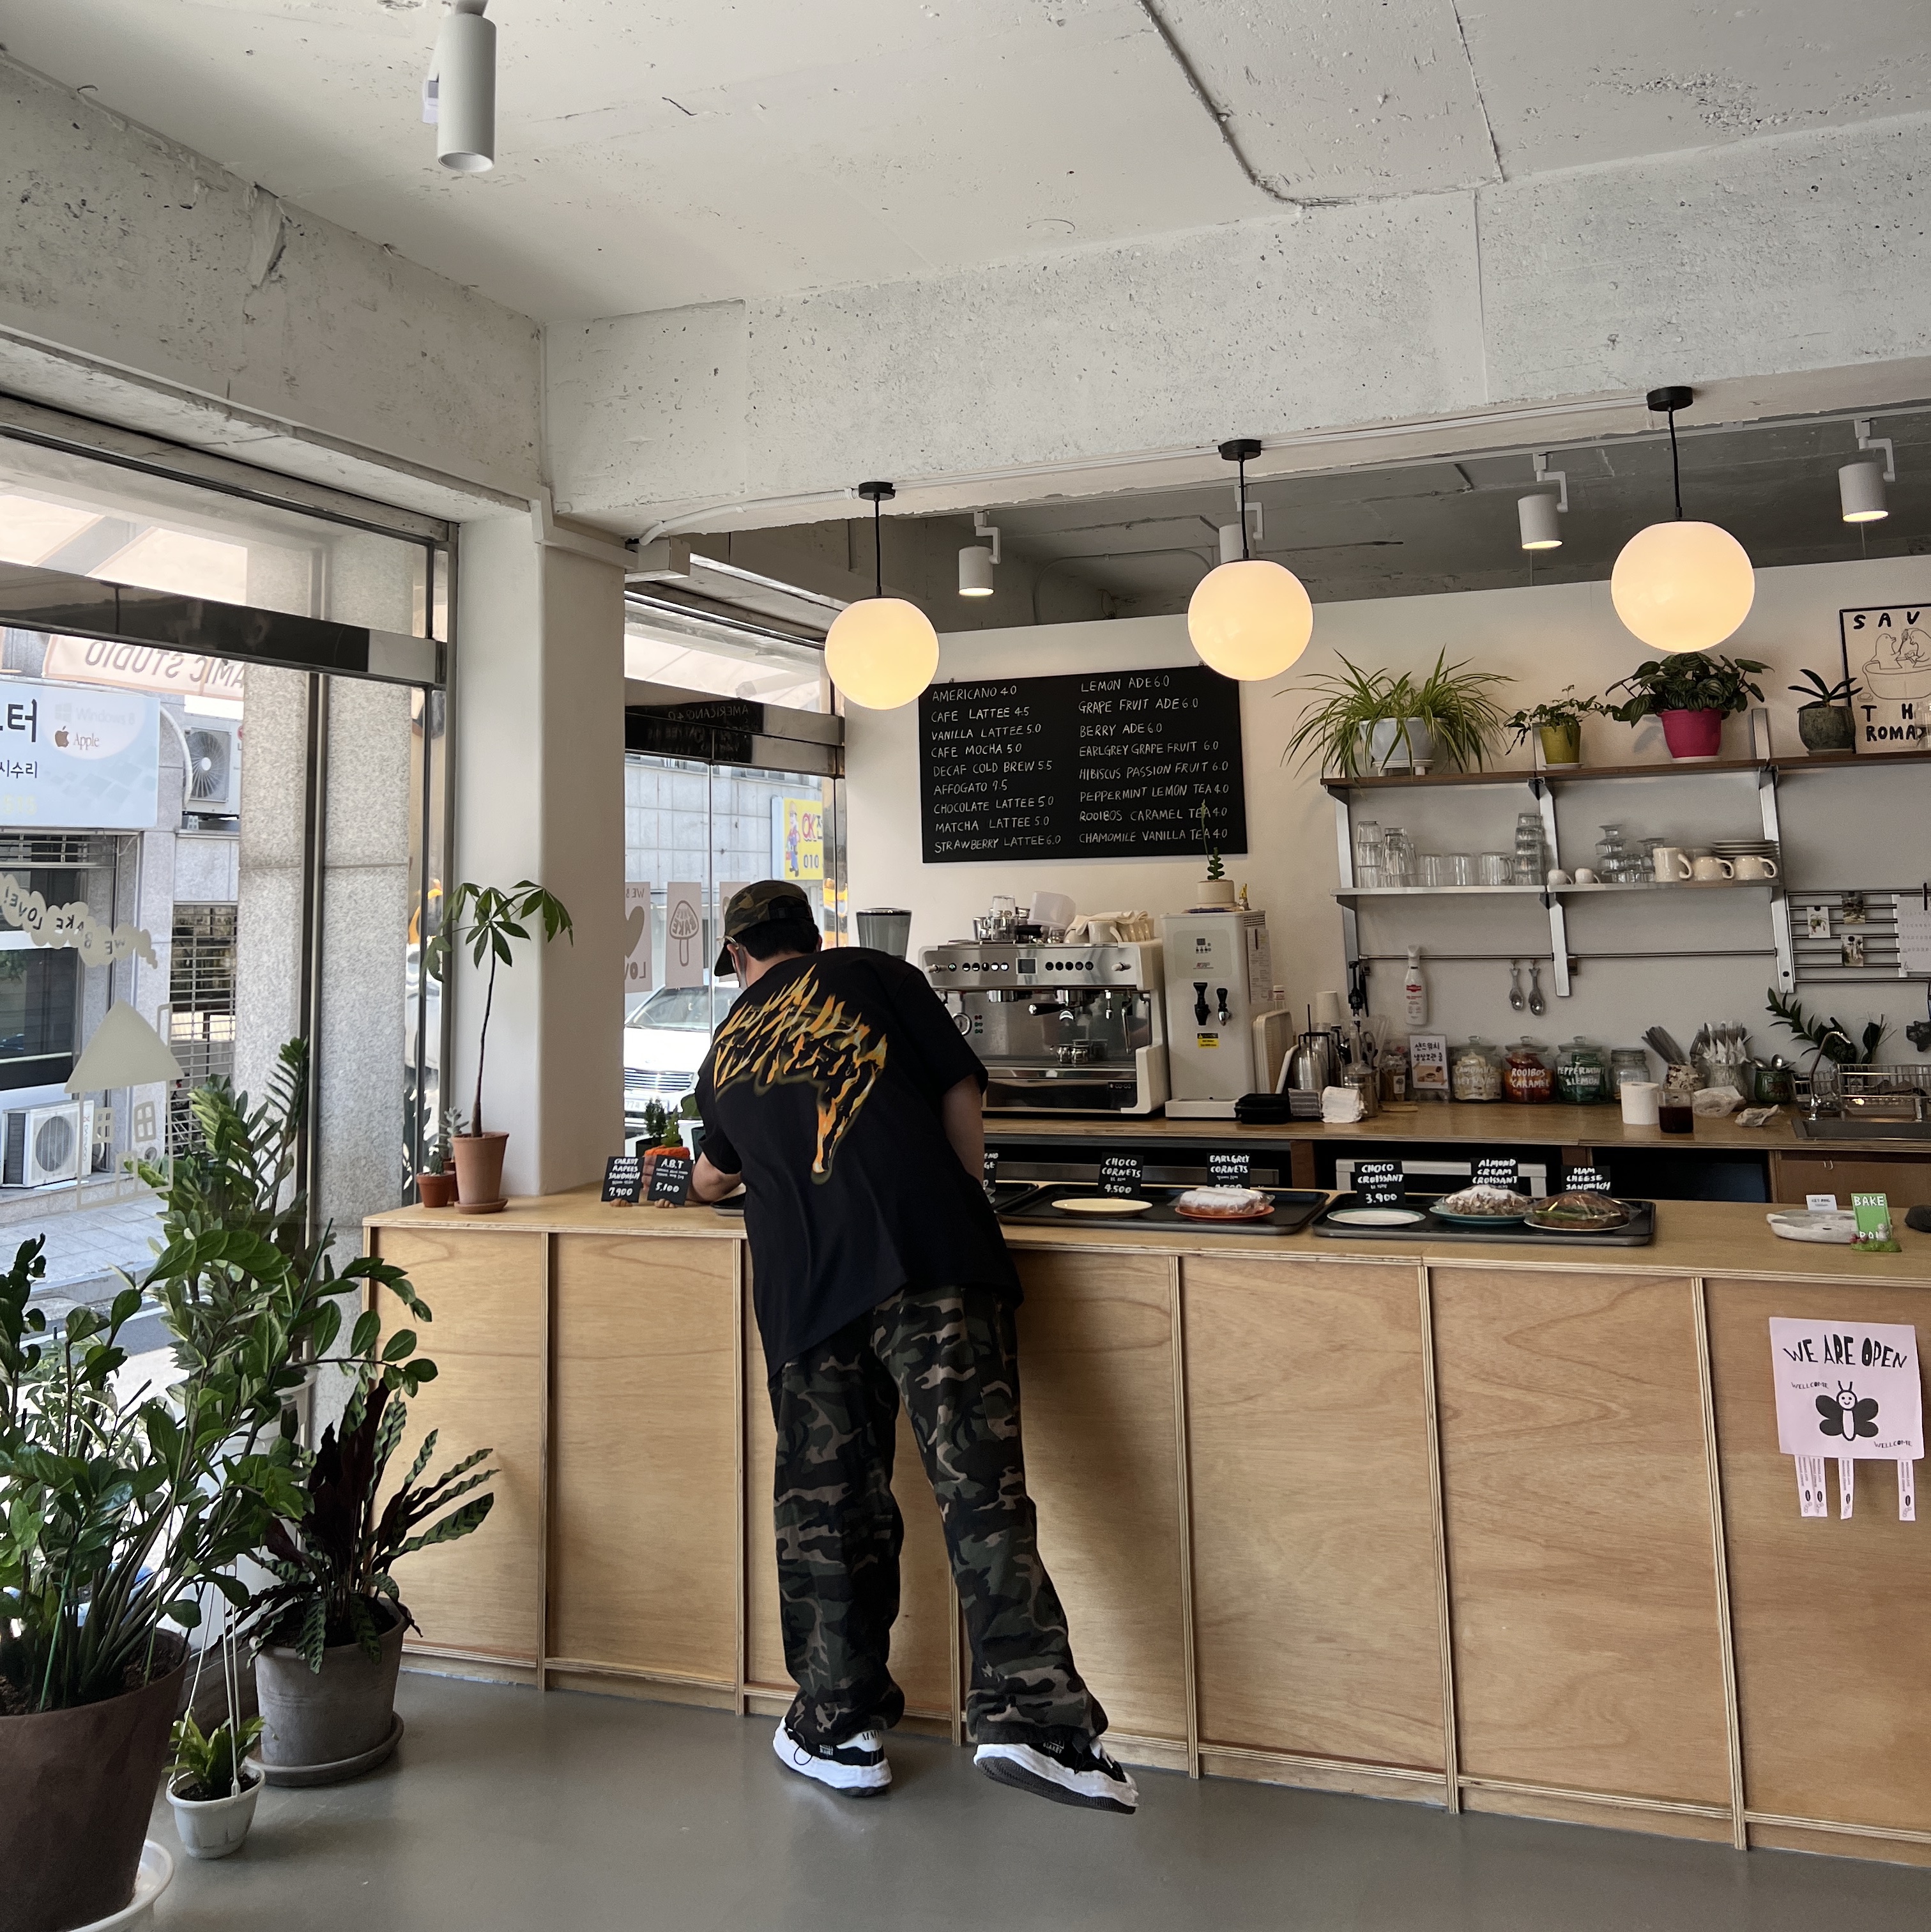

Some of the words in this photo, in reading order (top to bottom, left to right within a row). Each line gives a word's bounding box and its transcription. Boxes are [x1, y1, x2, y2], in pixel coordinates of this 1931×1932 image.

[1081, 678, 1121, 692] LEMON
[1128, 677, 1152, 689] ADE
[933, 687, 997, 703] AMERICANO
[1078, 700, 1113, 714] GRAPE
[1119, 698, 1149, 710] FRUIT
[1155, 698, 1180, 709] ADE
[1182, 698, 1198, 709] 6.0
[0, 698, 37, 742] 터
[931, 710, 958, 723] CAFE
[968, 707, 1010, 720] LATTEE
[1014, 707, 1030, 716] 4.5
[931, 729, 973, 740] VANILLA
[981, 725, 1024, 738] LATTEE
[1027, 723, 1042, 733] 5.0
[1080, 724, 1117, 738] BERRY
[1122, 723, 1145, 734] ADE
[73, 732, 100, 751] Apple
[1079, 744, 1129, 757] EARLGREY
[1131, 743, 1164, 755] GRAPE
[1167, 741, 1198, 753] FRUIT
[931, 747, 958, 758] CAFE
[965, 743, 1003, 755] MOCHA
[933, 764, 967, 777] DECAF
[973, 762, 998, 774] COLD
[1004, 761, 1035, 772] BREW
[1079, 768, 1121, 781] HIBISCUS
[1126, 763, 1172, 779] PASSION
[1175, 762, 1209, 773] FRUIT
[933, 782, 988, 795] AFFOGATO
[1080, 786, 1148, 802] PEPPERMINT
[1152, 785, 1187, 797] LEMON
[1193, 784, 1212, 794] TEA
[934, 801, 990, 814] CHOCOLATE
[996, 797, 1035, 809] LATTEE
[1079, 810, 1122, 822] ROOIBOS
[1130, 809, 1183, 821] CARAMEL
[1188, 807, 1211, 818] TEA
[935, 820, 979, 833] MATCHA
[989, 816, 1030, 829] LATTEE
[1079, 831, 1136, 843] CHAMOMILE
[1142, 829, 1186, 841] VANILLA
[1189, 828, 1210, 840] TEA
[935, 838, 999, 854] STRAWBERRY
[1004, 835, 1045, 847] LATTEE
[1046, 834, 1061, 845] 6.0
[804, 855, 819, 868] 010
[1511, 1068, 1545, 1077] ROOIBOS
[1511, 1078, 1549, 1088] CARAMEL
[1104, 1157, 1137, 1167] CHOCO
[1210, 1165, 1248, 1174] CORNETS
[1361, 1163, 1394, 1174] CHOCO
[1478, 1158, 1516, 1167] ALMOND
[1101, 1167, 1141, 1178] CORNETS
[1357, 1173, 1404, 1184] CROISSANT
[1477, 1167, 1512, 1176] CREAM
[1472, 1176, 1518, 1184] CROISSANT
[1565, 1181, 1611, 1191] SANDWICH
[1104, 1184, 1132, 1193] 4.500
[1365, 1192, 1398, 1204] 3.900
[1853, 1195, 1885, 1206] BAKE
[1783, 1338, 1819, 1362] WE
[1824, 1334, 1856, 1365] ARE
[1861, 1337, 1907, 1368] OPEN
